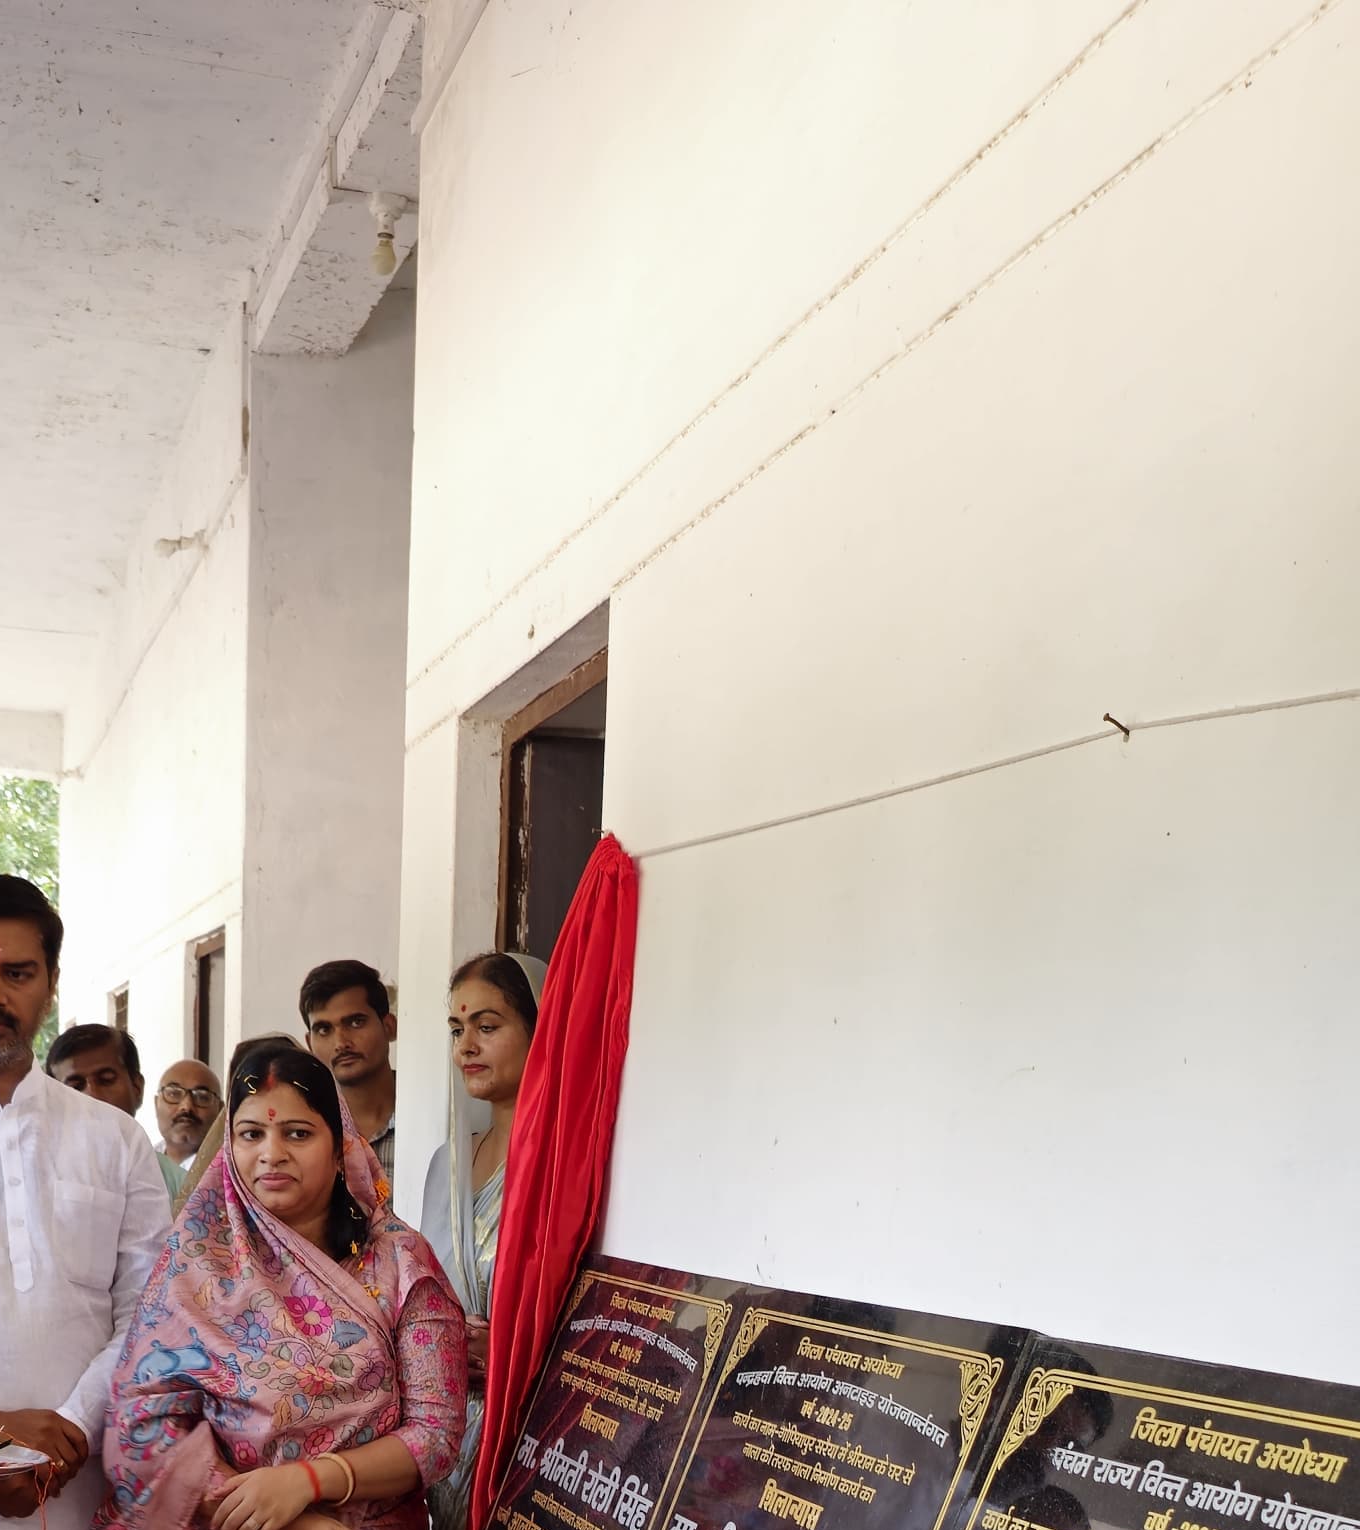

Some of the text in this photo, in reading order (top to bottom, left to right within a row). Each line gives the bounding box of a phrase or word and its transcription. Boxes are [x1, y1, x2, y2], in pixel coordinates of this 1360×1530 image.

[797, 1336, 906, 1380] जिला पंचायत अयोध्या
[539, 1437, 589, 1498] श्रीमती
[581, 1459, 623, 1516] रोली
[1051, 1441, 1095, 1478] पंचम
[1093, 1457, 1141, 1490] राज्य
[1185, 1480, 1262, 1522] आयोग
[1130, 1406, 1348, 1484] जिला पंचायत अयोध्या
[757, 1478, 824, 1530] शिलान्यास
